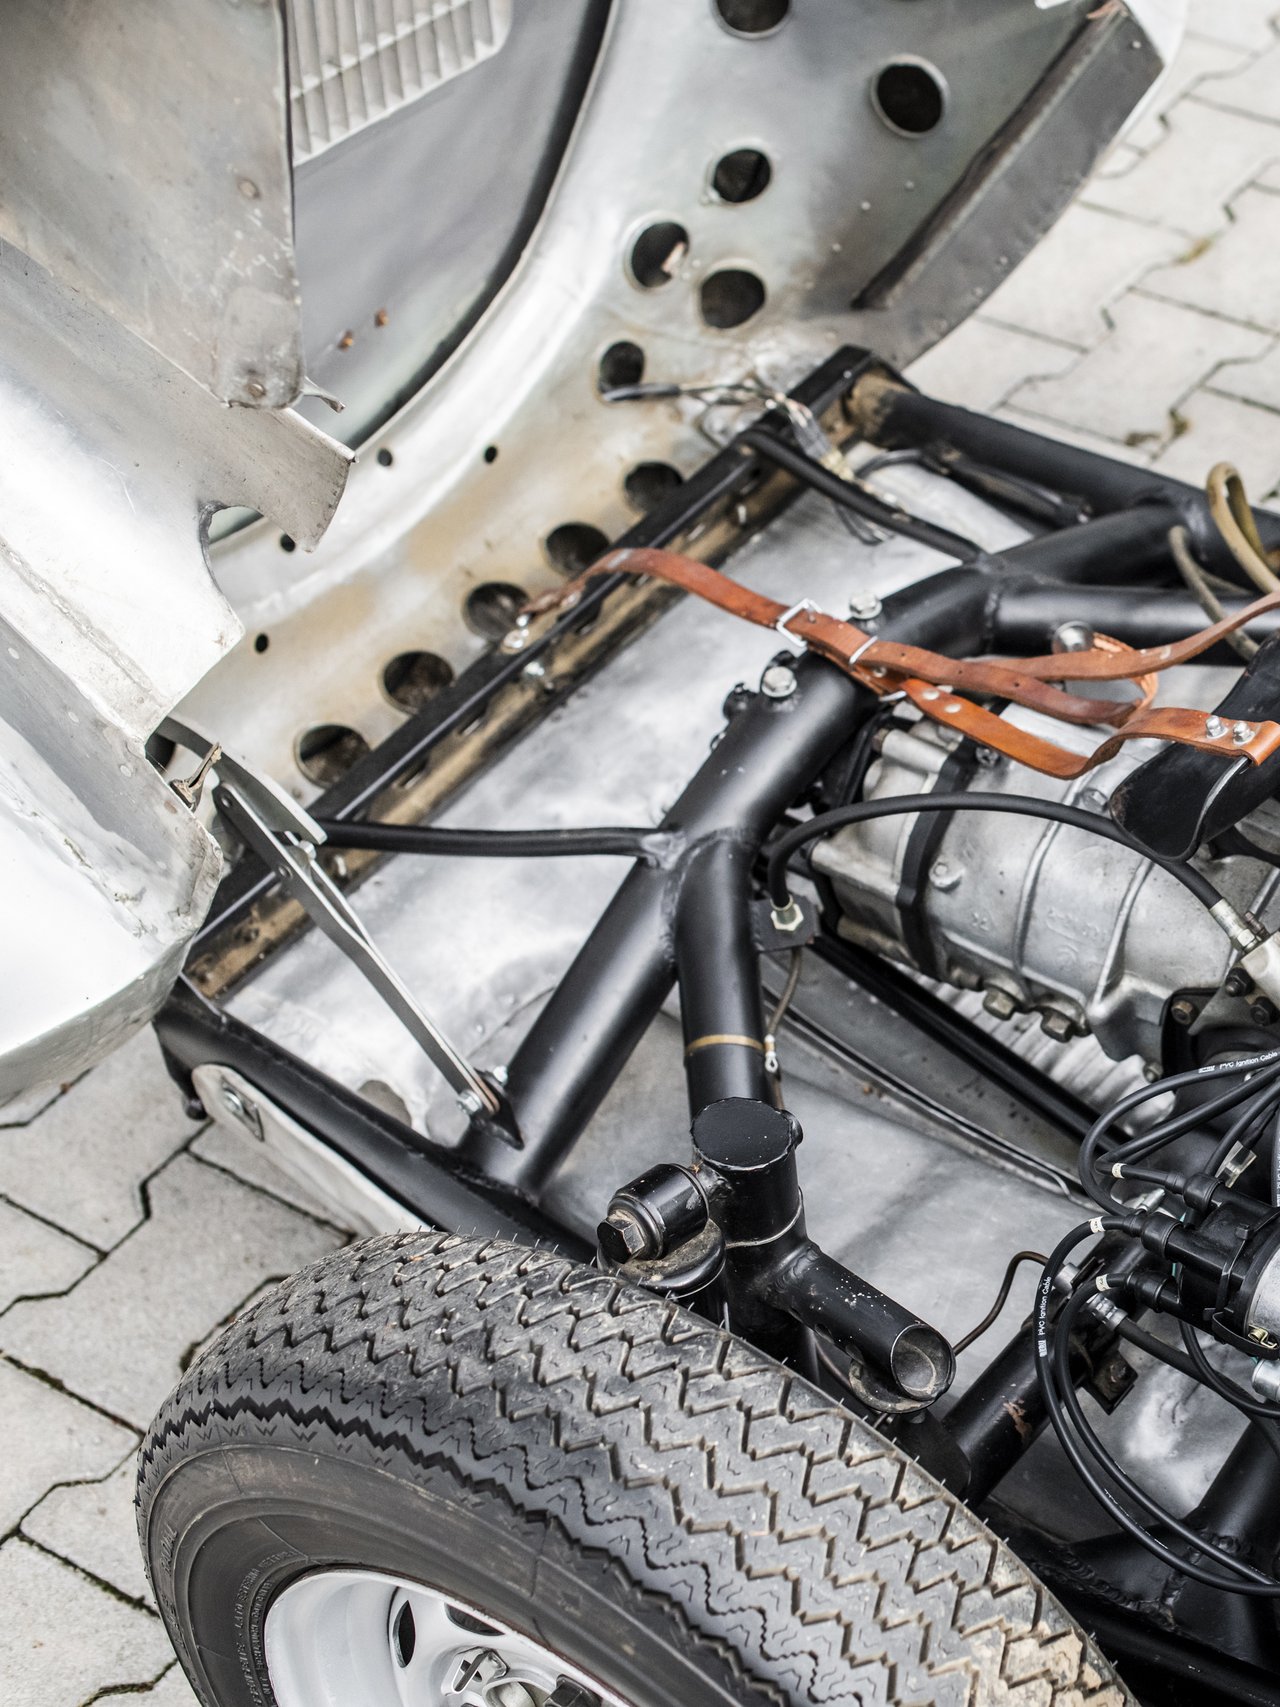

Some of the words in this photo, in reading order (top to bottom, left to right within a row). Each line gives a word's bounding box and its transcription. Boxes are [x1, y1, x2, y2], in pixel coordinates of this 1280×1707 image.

[1219, 1061, 1234, 1070] PVC
[1235, 1057, 1259, 1068] Ignition
[1259, 1051, 1278, 1062] Cable
[1041, 1276, 1052, 1295] Cable
[1039, 1295, 1048, 1319] Ignition
[1037, 1320, 1046, 1336] PVC
